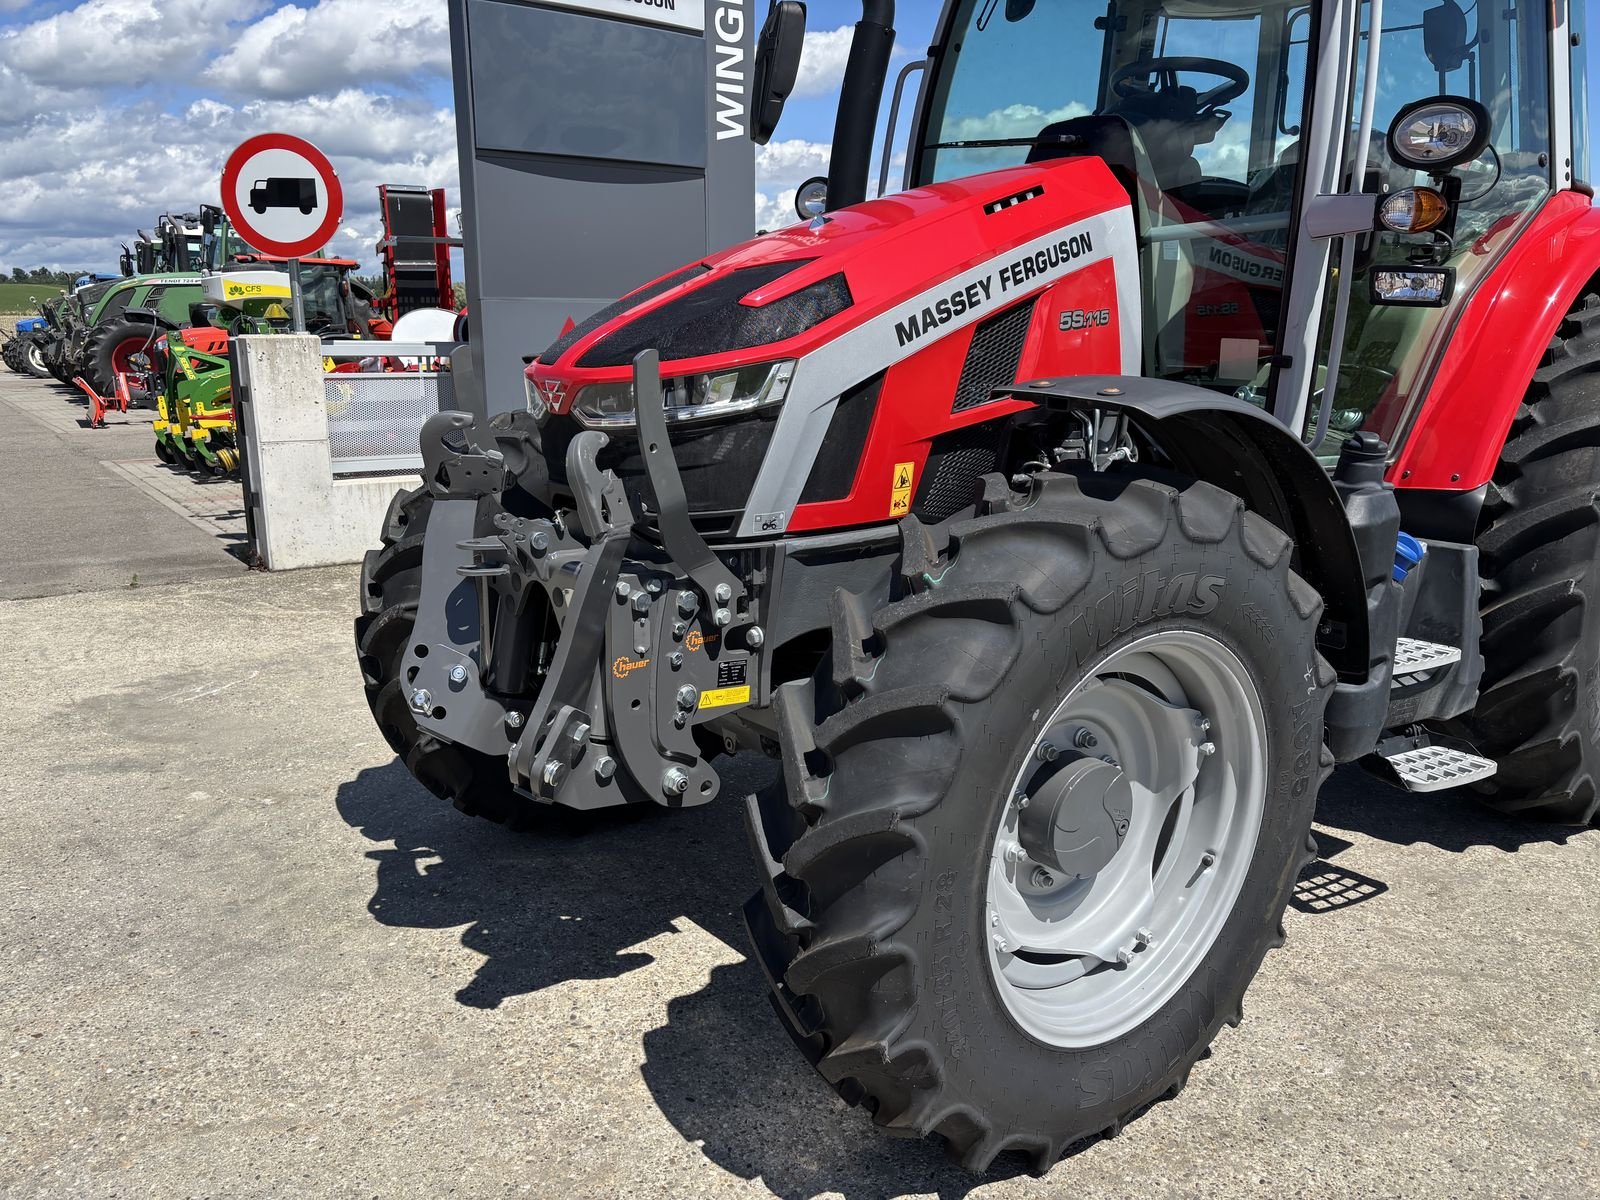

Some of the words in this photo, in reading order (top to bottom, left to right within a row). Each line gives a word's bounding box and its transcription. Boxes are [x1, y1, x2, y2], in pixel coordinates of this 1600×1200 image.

[715, 0, 744, 140] WING
[894, 275, 992, 347] MASSEY
[999, 232, 1093, 292] FERGUSON
[1059, 309, 1110, 331] 5S.115
[691, 633, 719, 646] hauer
[1056, 568, 1227, 690] Mitas
[619, 659, 650, 672] hauer
